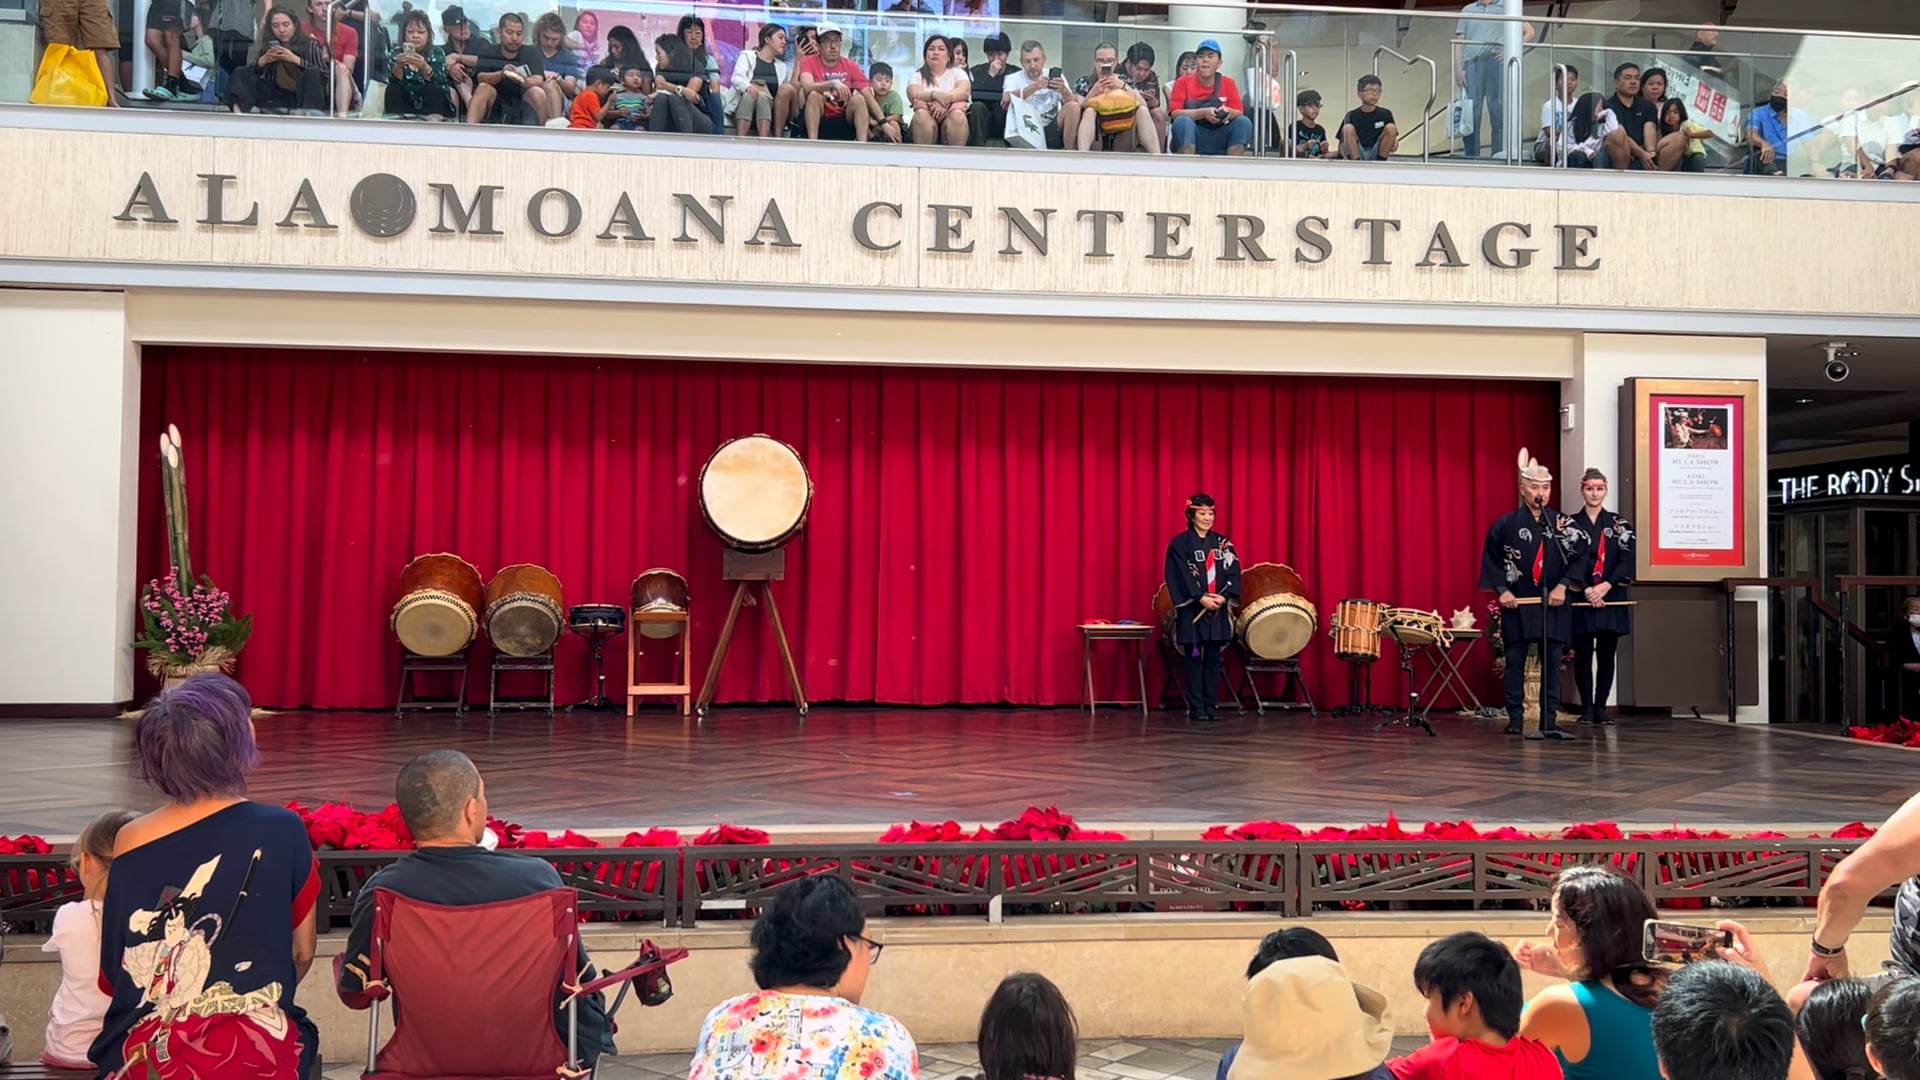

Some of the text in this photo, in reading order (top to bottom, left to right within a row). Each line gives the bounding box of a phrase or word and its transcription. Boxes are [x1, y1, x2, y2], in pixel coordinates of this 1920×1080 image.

[113, 171, 338, 230] ALA
[428, 183, 802, 249] MOANA
[1778, 475, 1820, 504] THE
